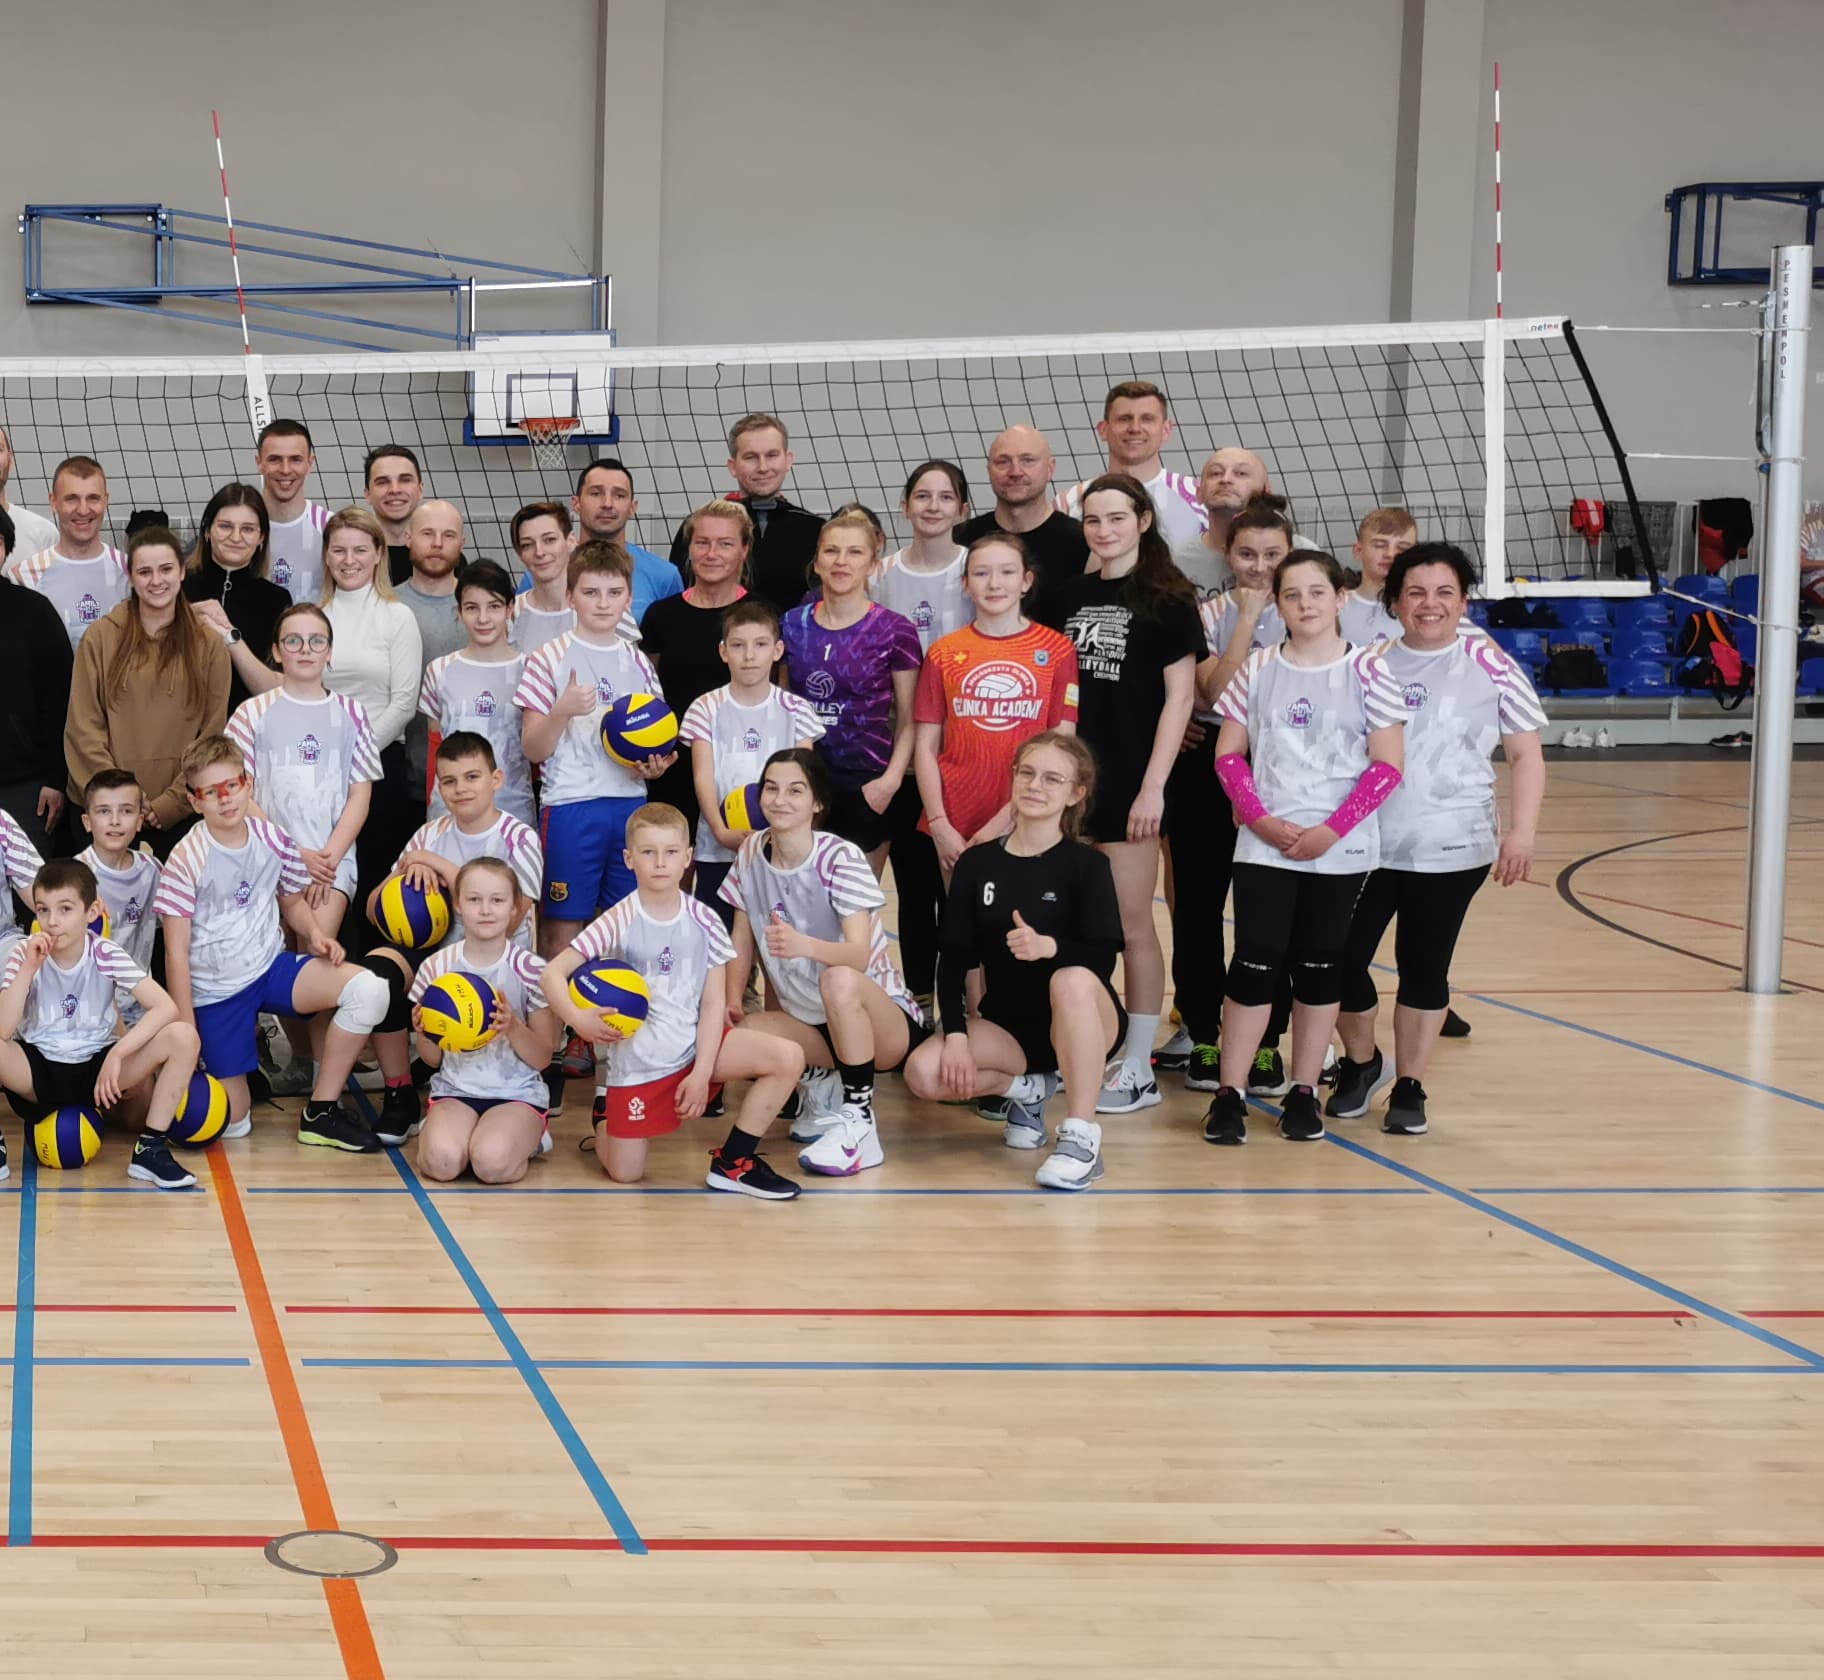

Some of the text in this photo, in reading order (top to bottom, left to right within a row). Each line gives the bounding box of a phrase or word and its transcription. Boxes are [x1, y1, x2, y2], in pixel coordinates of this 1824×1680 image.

[824, 643, 832, 662] 1
[1078, 659, 1121, 675] LLEYBALL
[808, 702, 846, 715] OLLEY
[991, 699, 1044, 719] ACADEMY
[983, 881, 996, 906] 6
